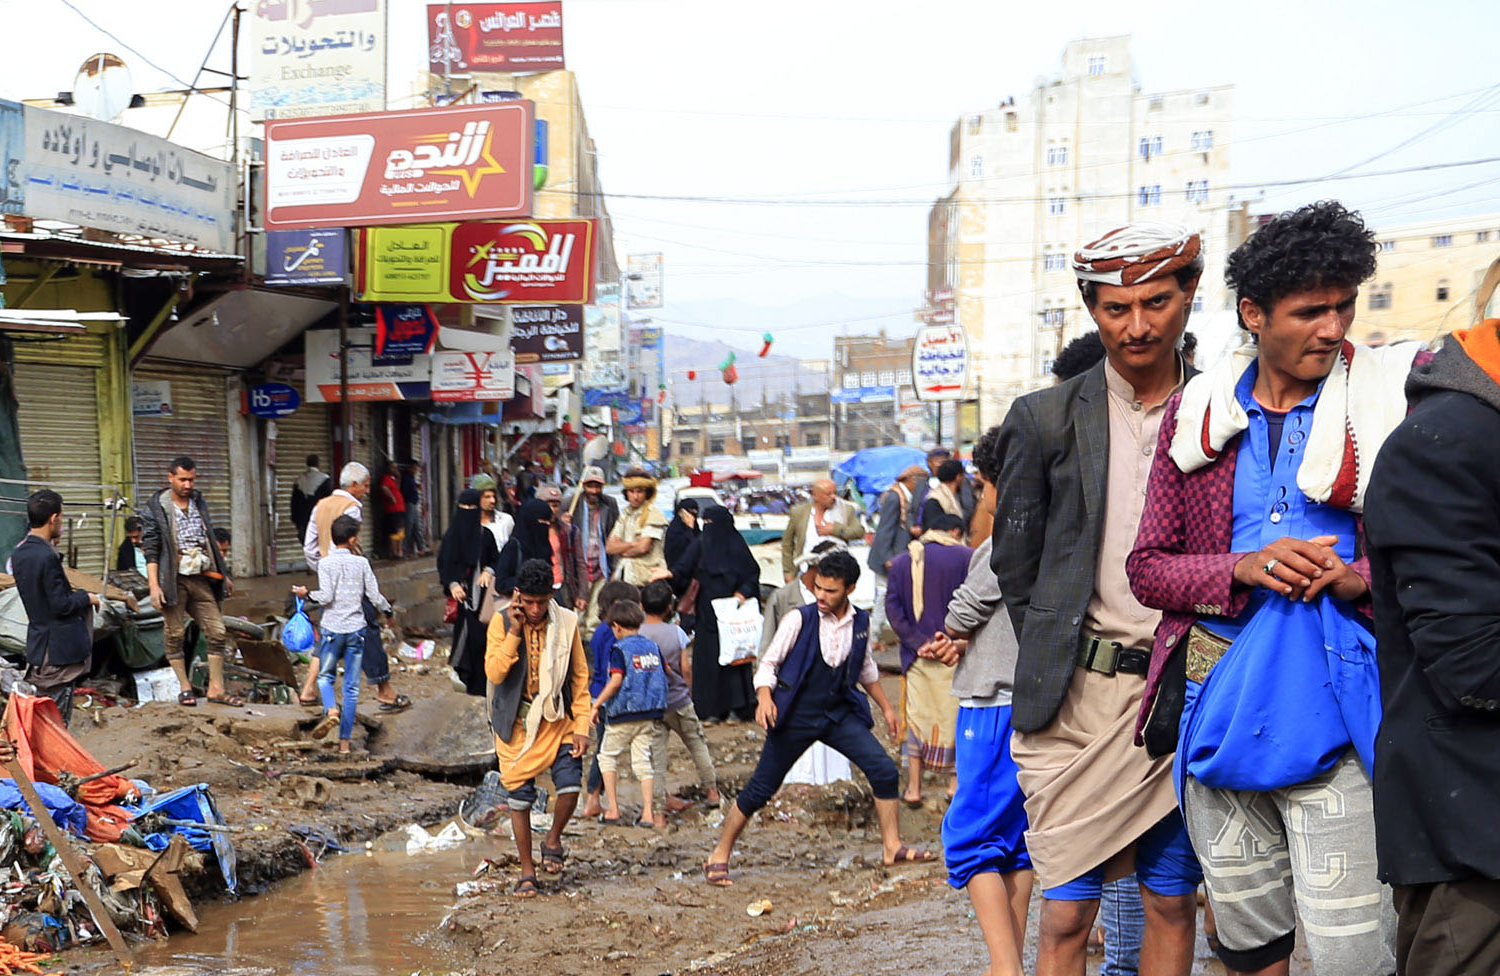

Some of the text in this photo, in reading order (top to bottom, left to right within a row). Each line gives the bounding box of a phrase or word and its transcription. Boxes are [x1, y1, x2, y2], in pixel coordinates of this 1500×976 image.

[262, 31, 376, 59] والتحويلات
[280, 63, 353, 81] Exchange
[385, 120, 490, 179] النجم
